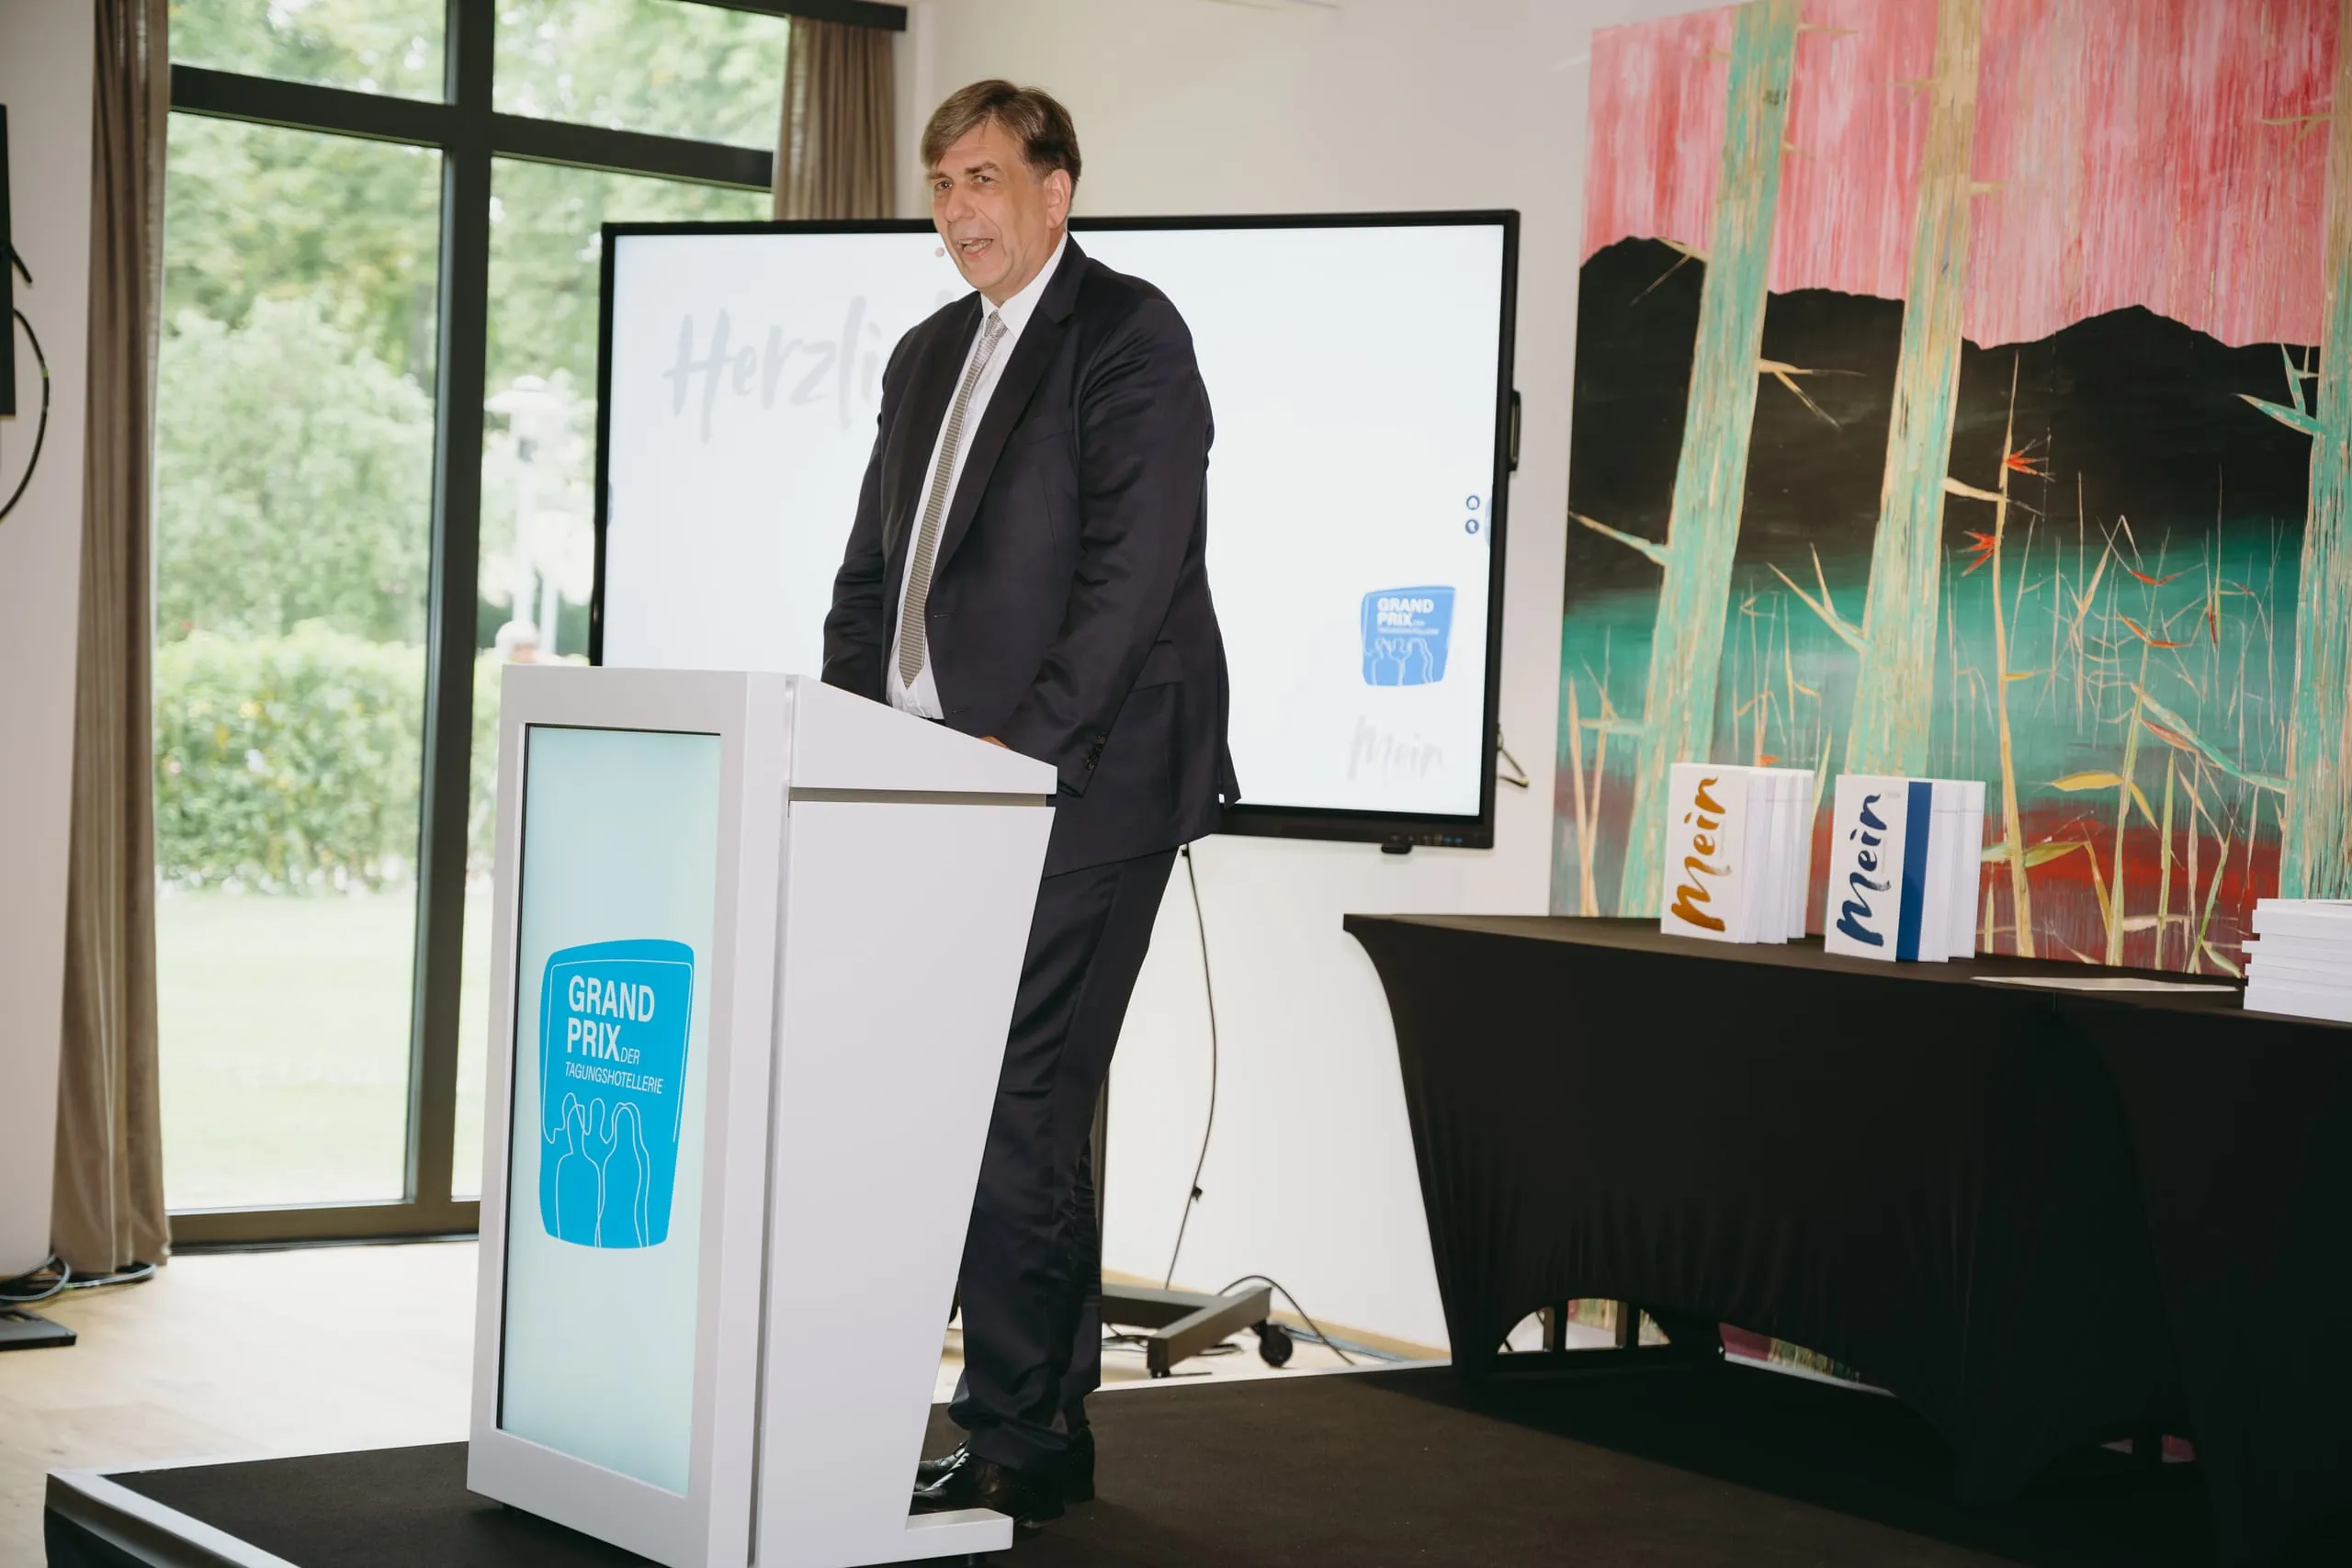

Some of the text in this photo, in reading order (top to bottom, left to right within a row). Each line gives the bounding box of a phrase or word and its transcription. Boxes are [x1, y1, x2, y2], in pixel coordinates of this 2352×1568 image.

[1377, 597, 1434, 615] GRAND
[1377, 611, 1414, 627] PRIX
[1347, 714, 1445, 783] Mein
[1670, 774, 1732, 933] Mein
[1836, 793, 1892, 947] Mein
[568, 975, 655, 1022] GRAND
[567, 1017, 640, 1065] PRIX DER
[566, 1063, 663, 1094] TAGUNGSHOTELLERIE
